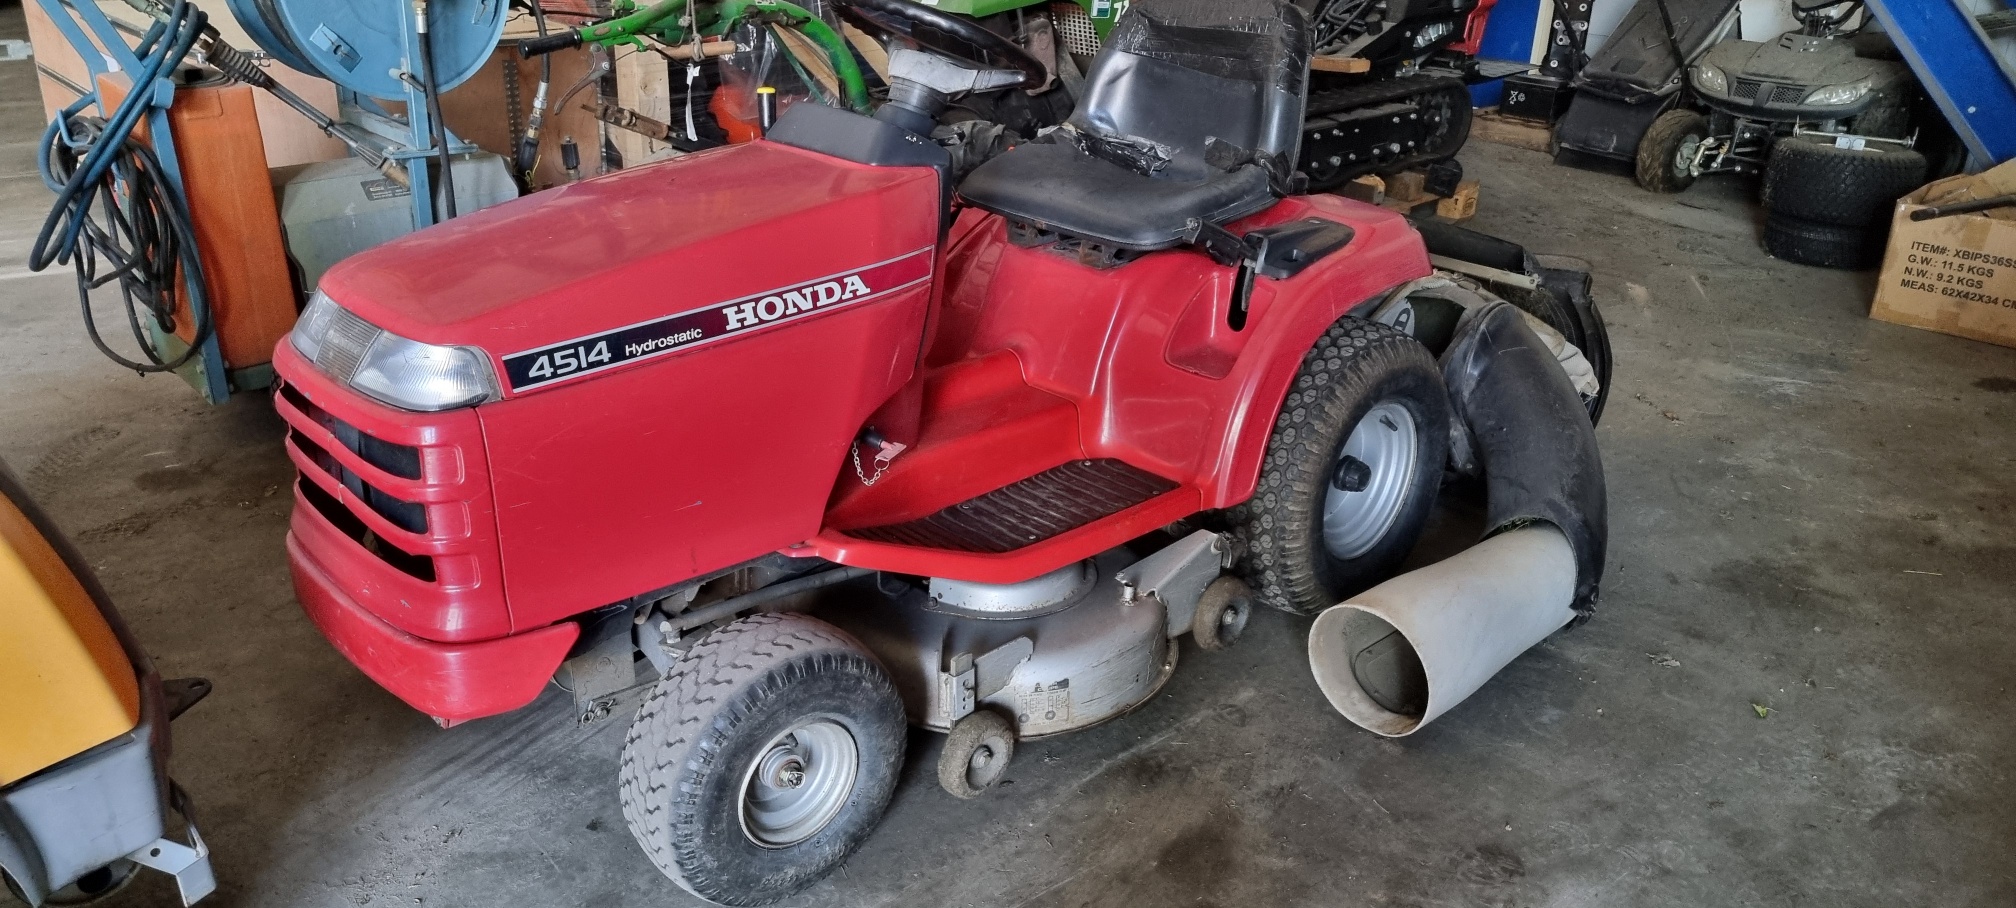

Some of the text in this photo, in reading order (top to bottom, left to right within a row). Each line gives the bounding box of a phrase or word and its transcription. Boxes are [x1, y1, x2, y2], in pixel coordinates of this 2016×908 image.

[1910, 241, 1950, 256] ITEM#:
[1904, 266, 1984, 289] N.W.: 9.2 KGS
[1907, 254, 1995, 278] G.W.: 11.5 KGS
[1900, 278, 1938, 294] MEAS:
[1941, 287, 1999, 305] 62X42X34
[528, 274, 871, 379] 4514 Hydrostatic HONDA
